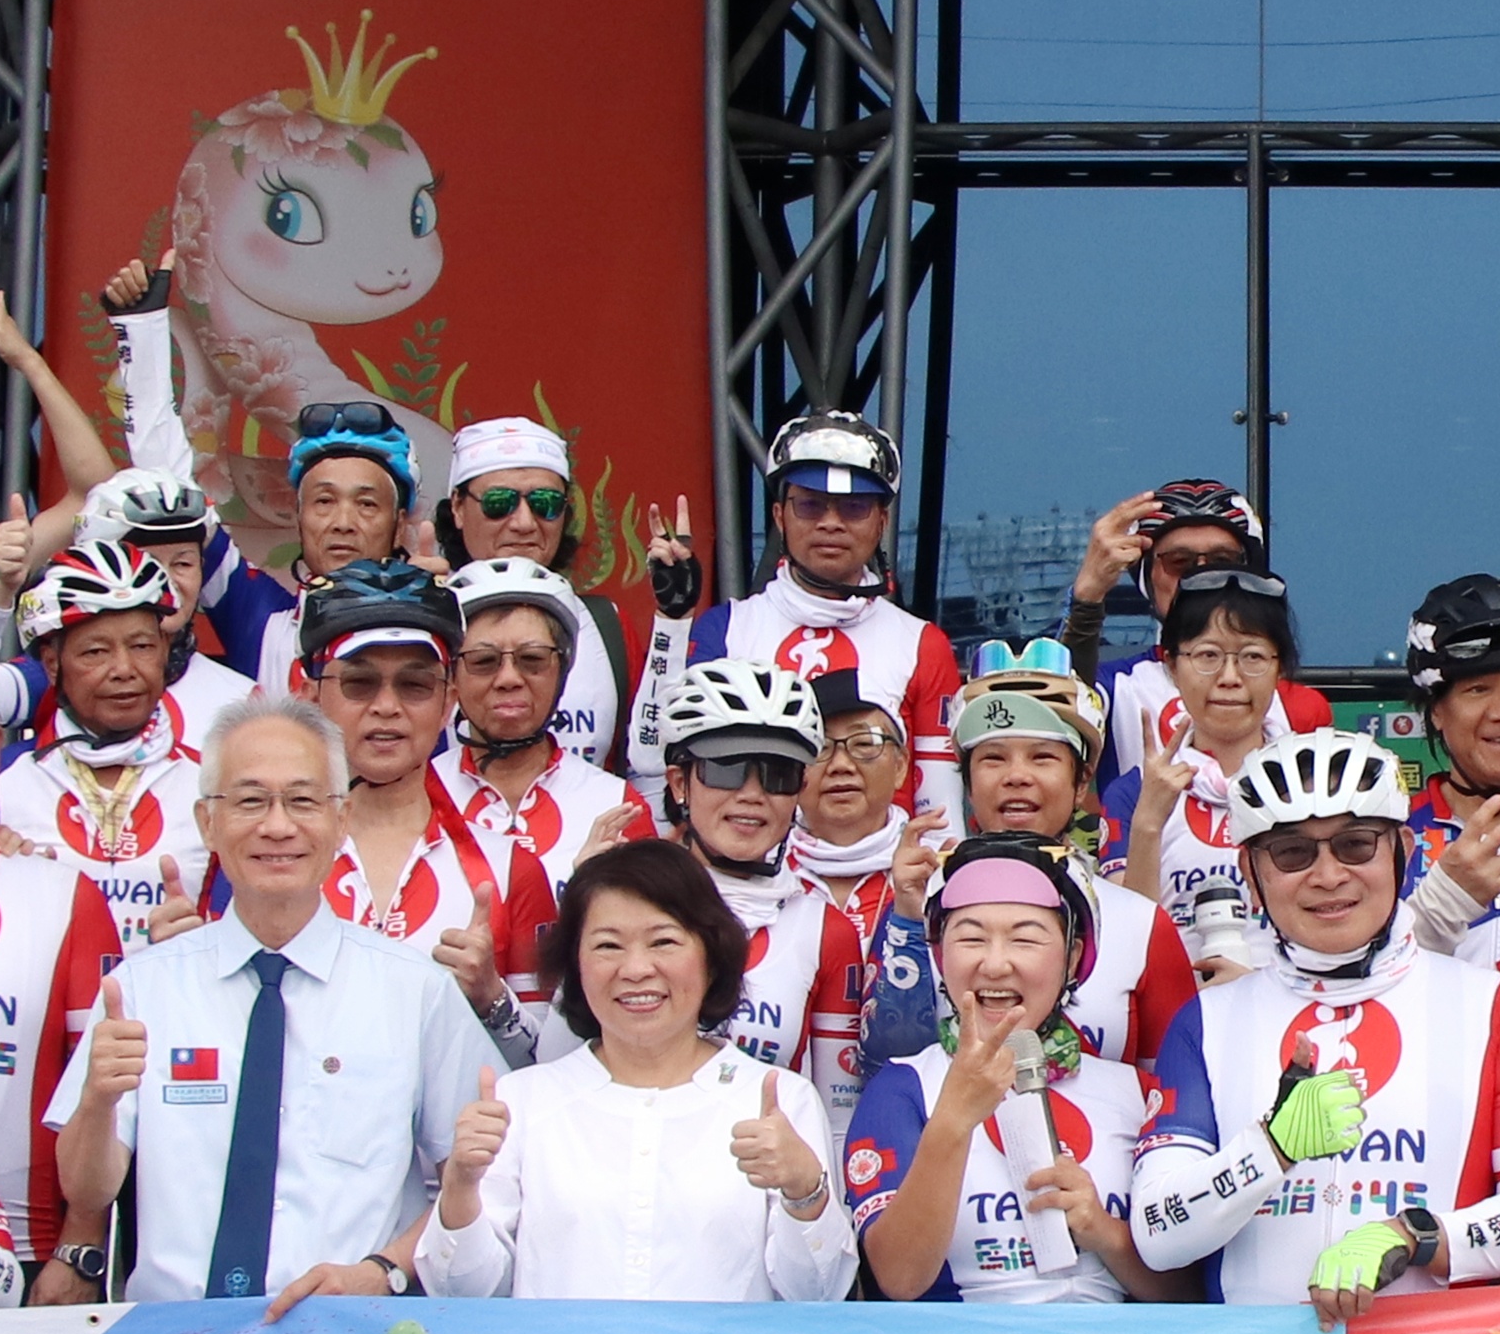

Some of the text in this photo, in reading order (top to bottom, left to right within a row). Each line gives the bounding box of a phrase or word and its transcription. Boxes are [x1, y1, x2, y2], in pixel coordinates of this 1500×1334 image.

[1143, 1153, 1264, 1237] 馬偕一四五
